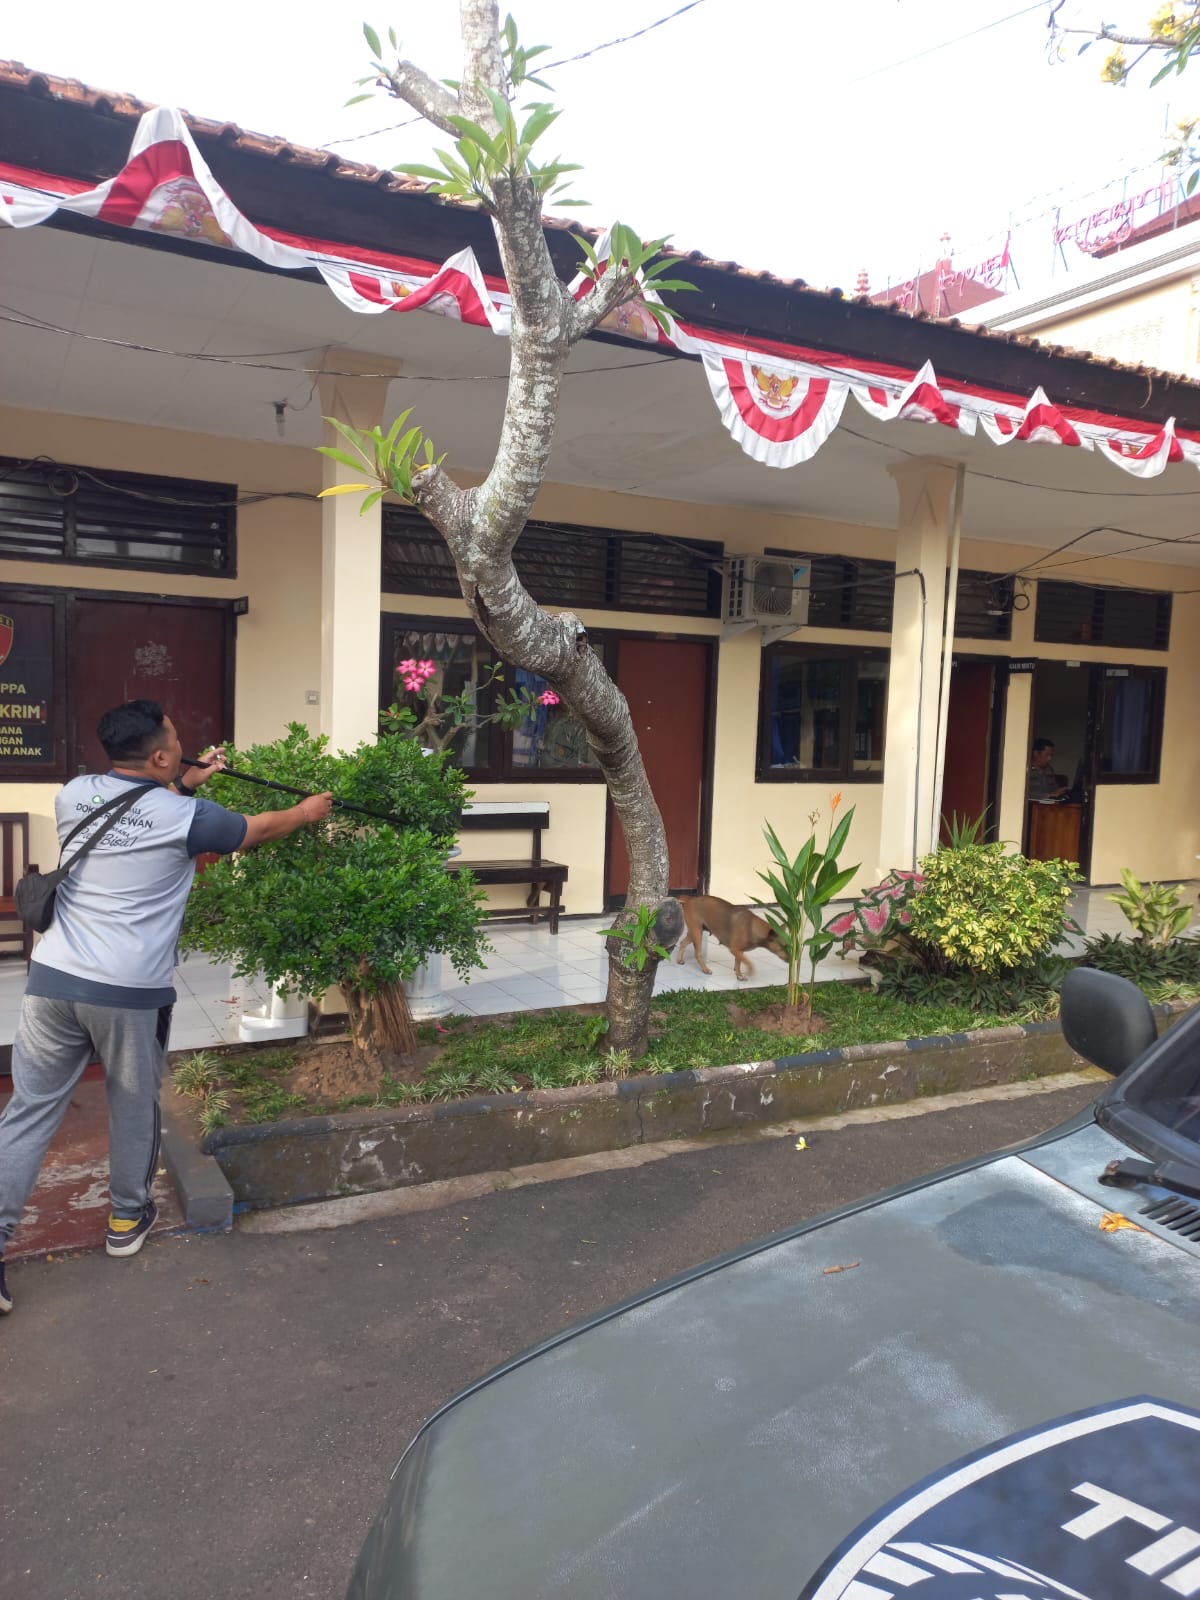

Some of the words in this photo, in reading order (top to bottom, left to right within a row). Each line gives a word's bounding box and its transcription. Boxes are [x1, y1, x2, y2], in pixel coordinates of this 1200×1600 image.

[1, 683, 26, 694] PPA
[0, 726, 23, 735] ANA
[12, 747, 42, 756] ANAK
[116, 816, 153, 829] EWAN
